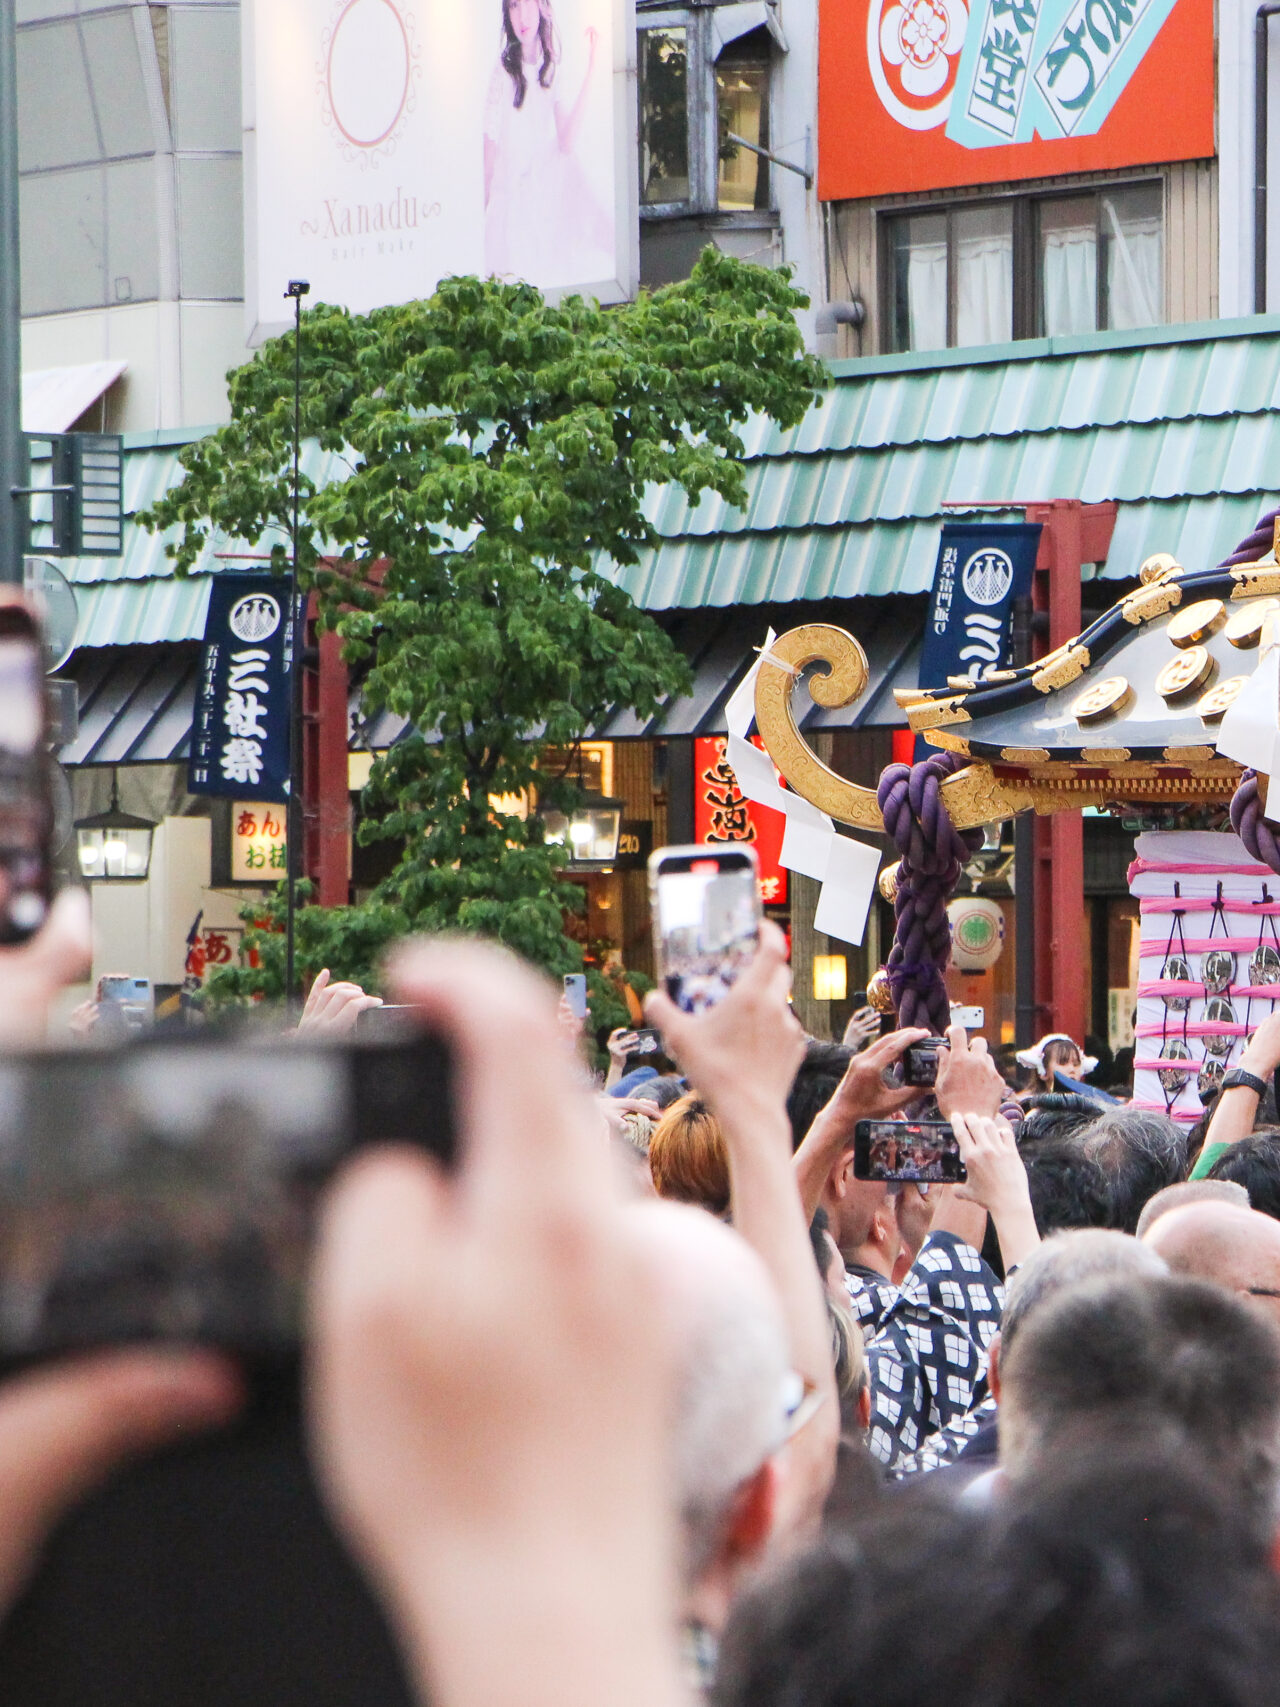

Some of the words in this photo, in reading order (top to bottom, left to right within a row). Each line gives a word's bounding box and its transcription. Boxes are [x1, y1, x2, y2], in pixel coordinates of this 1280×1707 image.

[323, 186, 418, 239] Xanadu
[220, 649, 271, 785] 三社祭
[236, 810, 287, 838] あん
